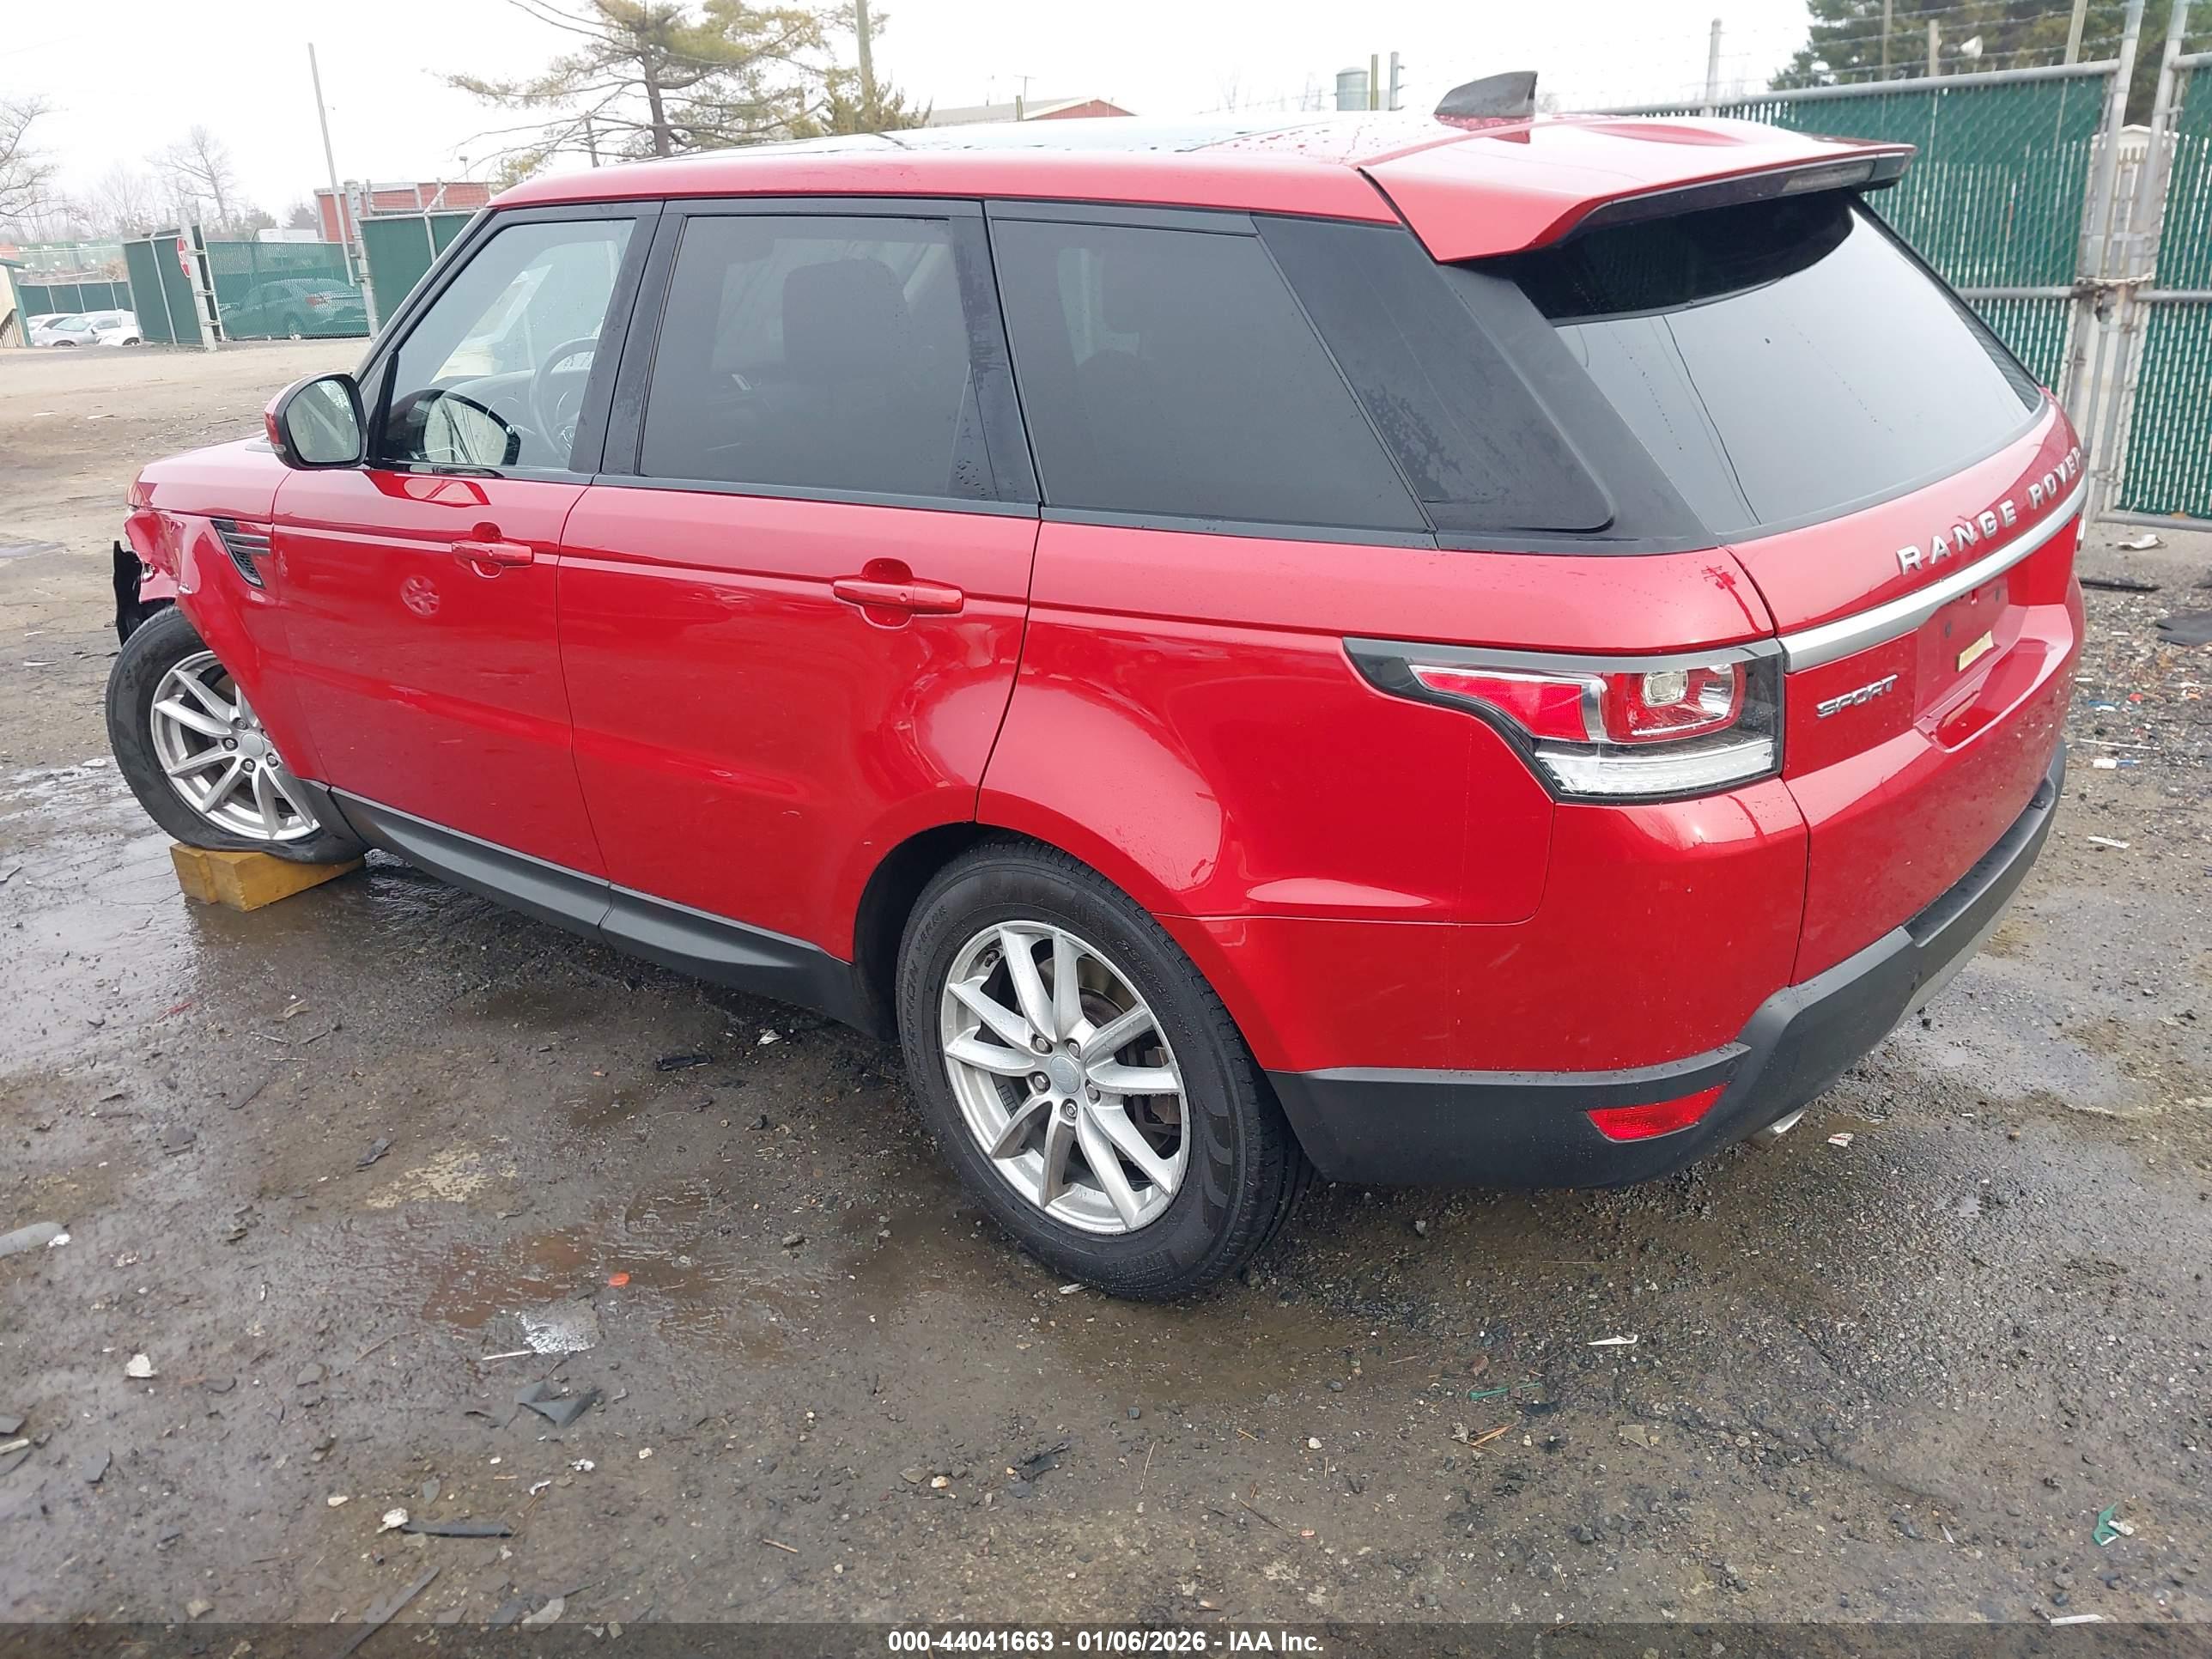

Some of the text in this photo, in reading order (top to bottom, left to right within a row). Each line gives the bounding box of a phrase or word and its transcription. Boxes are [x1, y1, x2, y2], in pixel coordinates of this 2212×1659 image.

[1896, 447, 2081, 575] RANGE ROVER
[1816, 673, 1898, 719] SPORT
